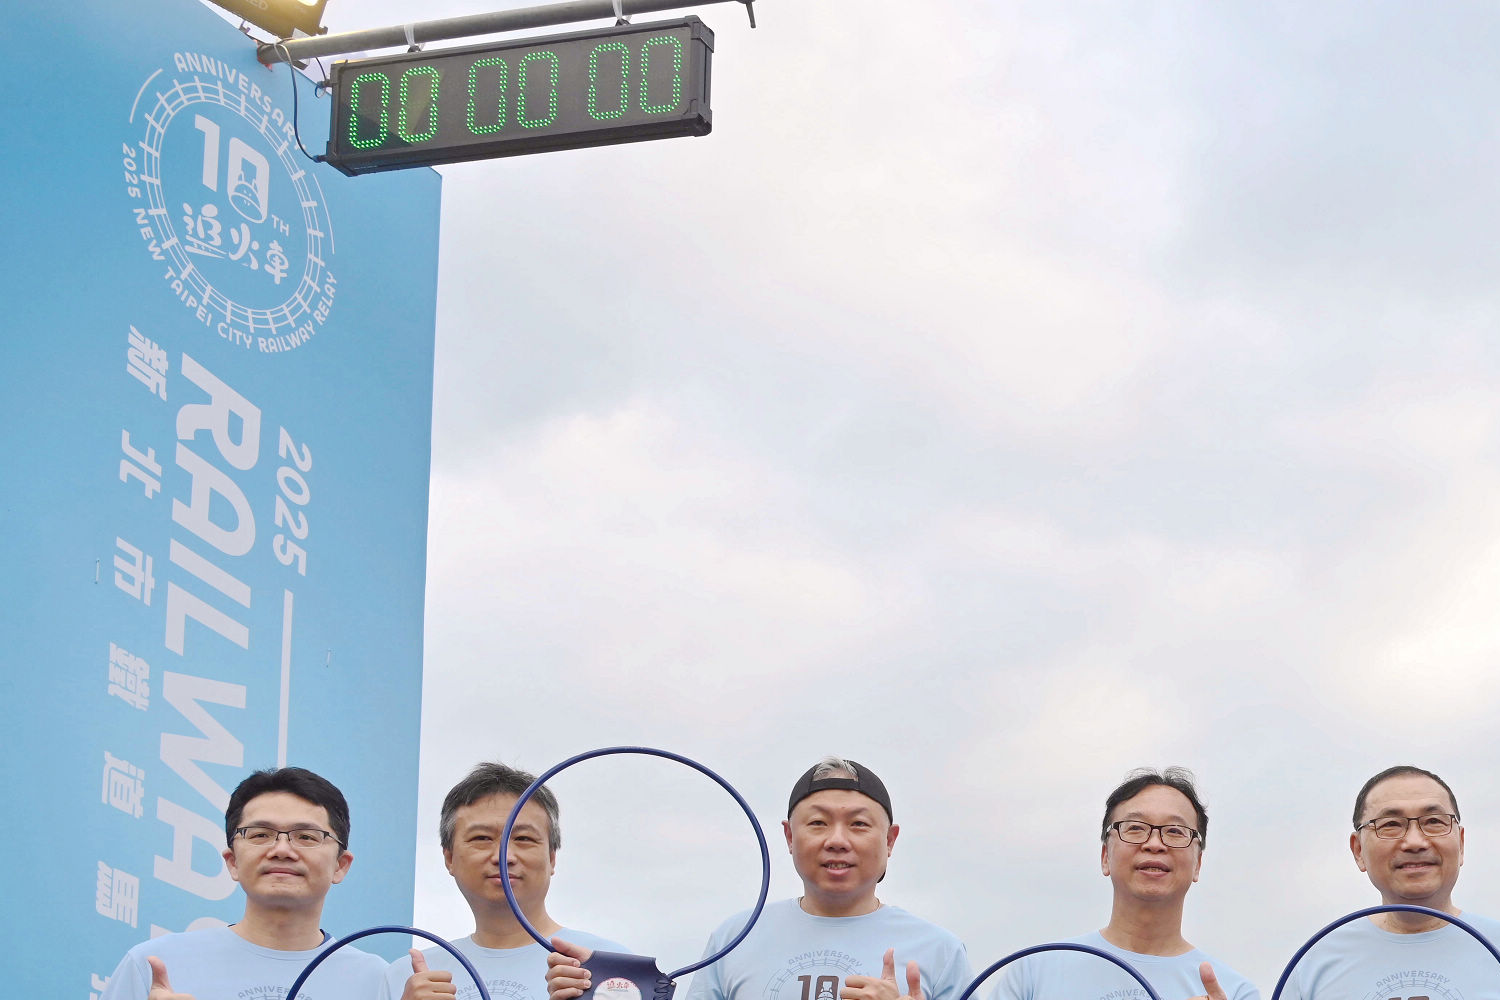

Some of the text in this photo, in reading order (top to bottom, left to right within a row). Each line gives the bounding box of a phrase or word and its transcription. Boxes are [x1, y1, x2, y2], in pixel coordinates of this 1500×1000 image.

[348, 36, 682, 151] 00 00 00
[194, 114, 290, 237] 10 TH
[122, 143, 338, 354] 2025 NEW TAIPEI CITY RAILWAY RELAY
[182, 202, 289, 285] 追火車
[272, 425, 313, 577] 2025
[150, 352, 262, 932] RAILWA
[788, 949, 862, 967] ANNIVERSARY
[1376, 970, 1450, 988] ANNIVERSARY
